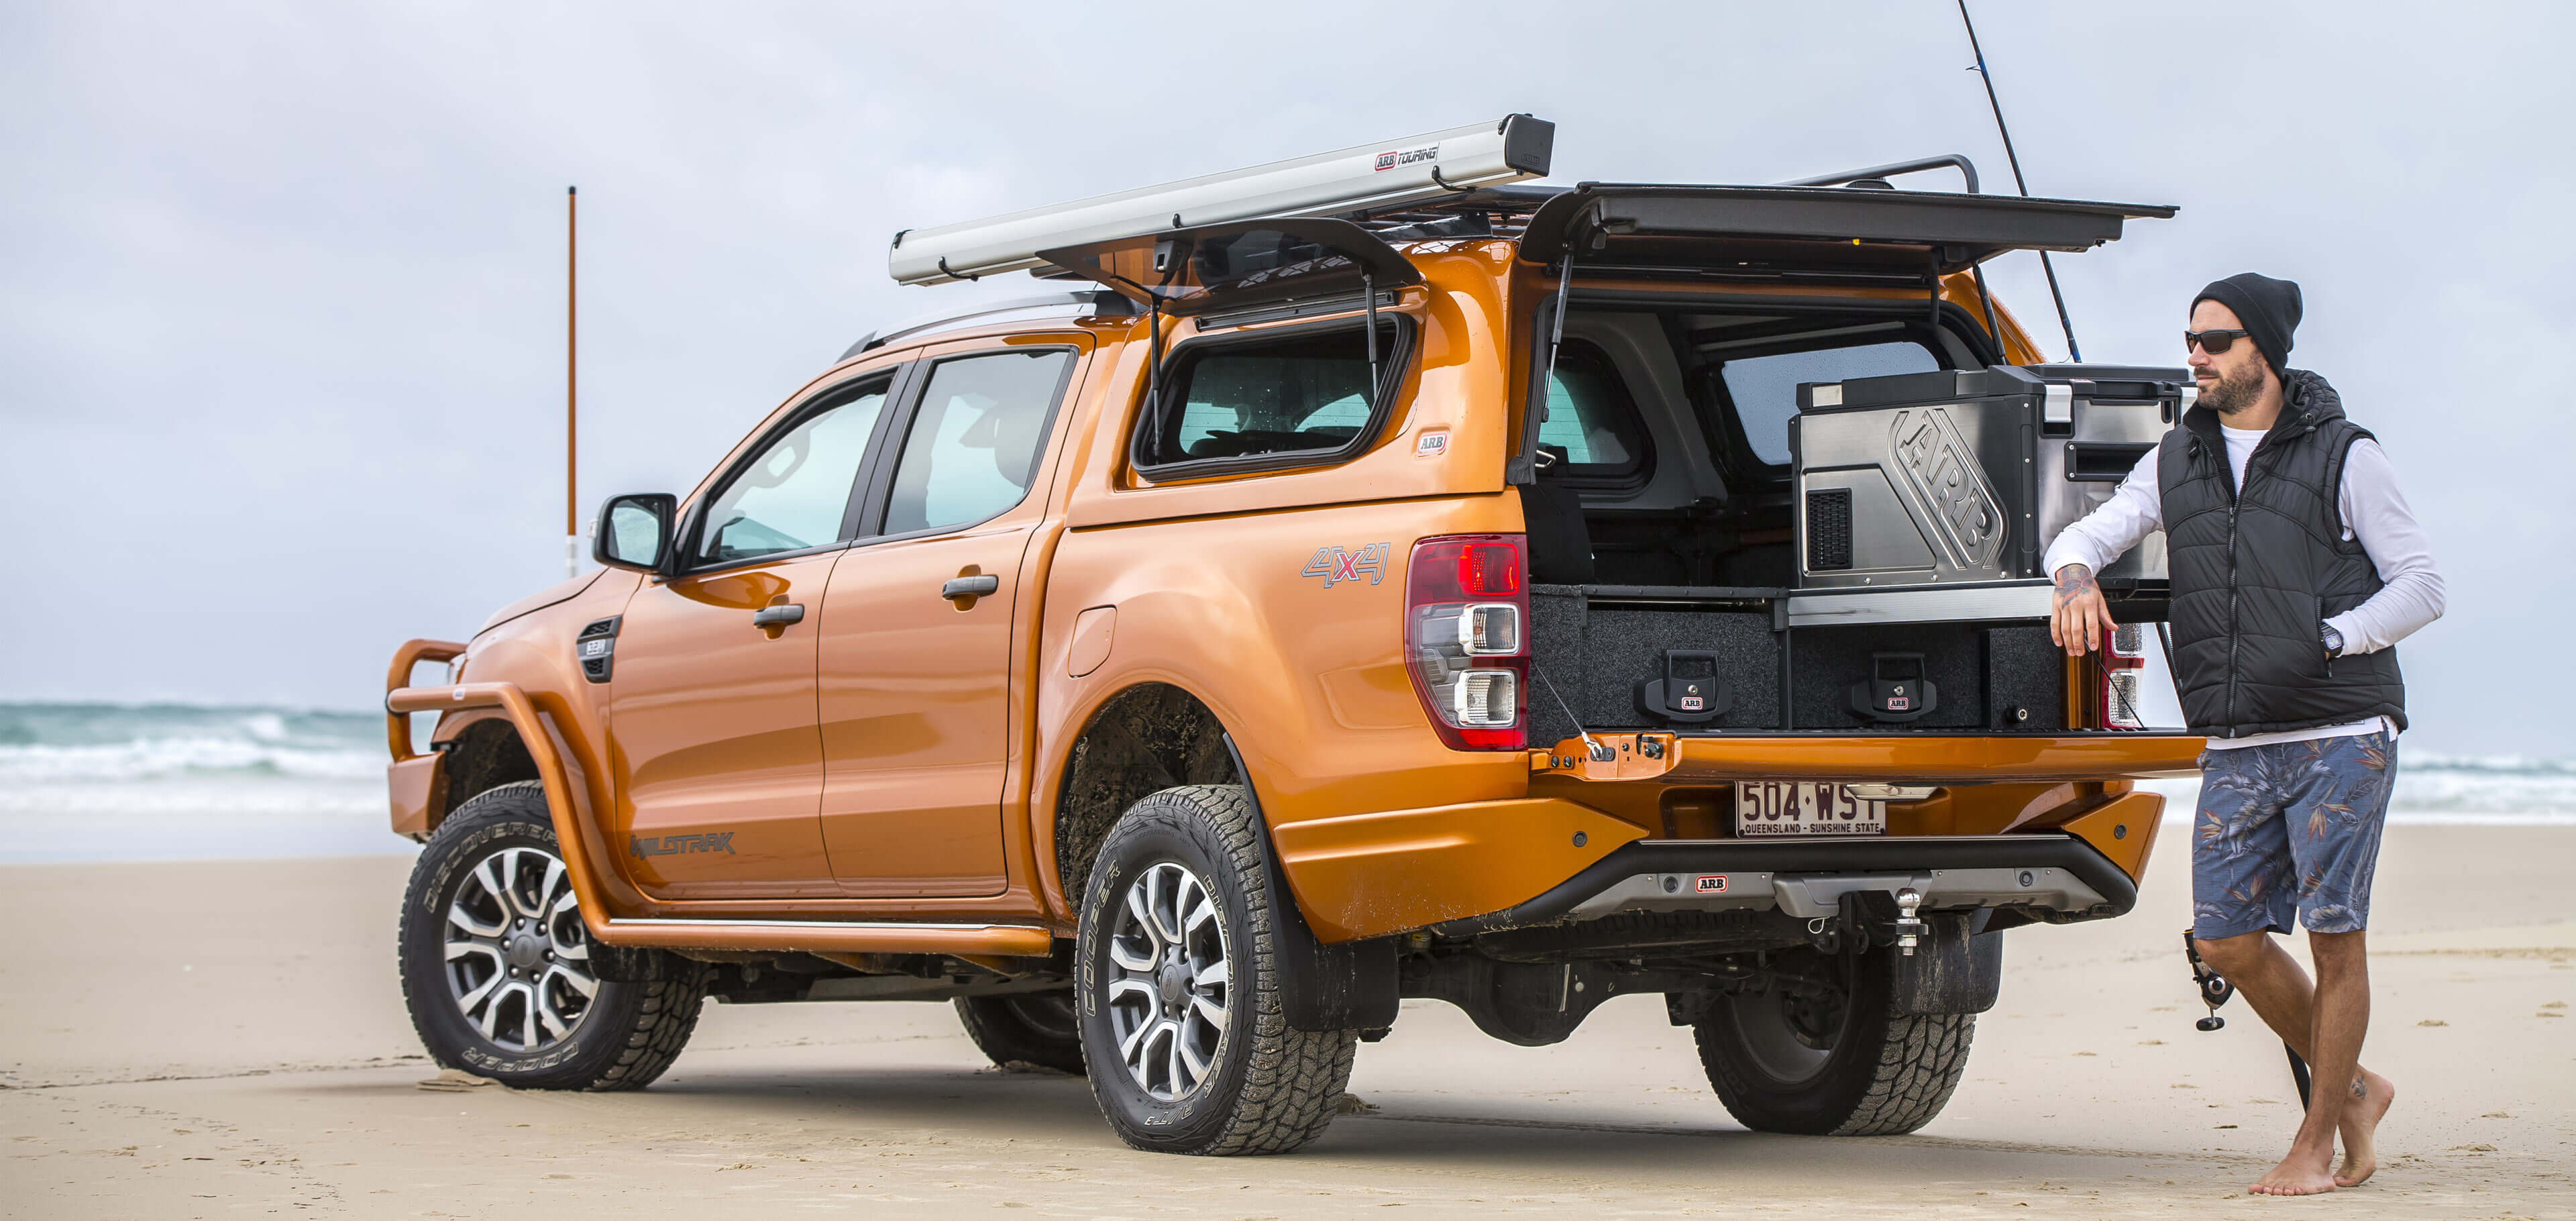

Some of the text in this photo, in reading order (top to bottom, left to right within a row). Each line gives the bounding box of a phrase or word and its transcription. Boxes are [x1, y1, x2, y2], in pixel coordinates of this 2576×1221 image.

[1377, 146, 1438, 167] ARB TOURING
[1420, 436, 1444, 450] ARB
[1900, 410, 1994, 563] ARB
[1746, 823, 1801, 834] QUEENSLAND
[1810, 823, 1851, 833] SUNSHINE
[1856, 822, 1880, 833] STATE
[630, 832, 736, 861] WILDTRAK
[423, 821, 559, 914] DISCOVERER
[1699, 879, 1724, 889] ARB
[1083, 859, 1121, 1017] COOPER
[1204, 875, 1234, 1099] DISCOVERER
[461, 1041, 580, 1072] COOPER
